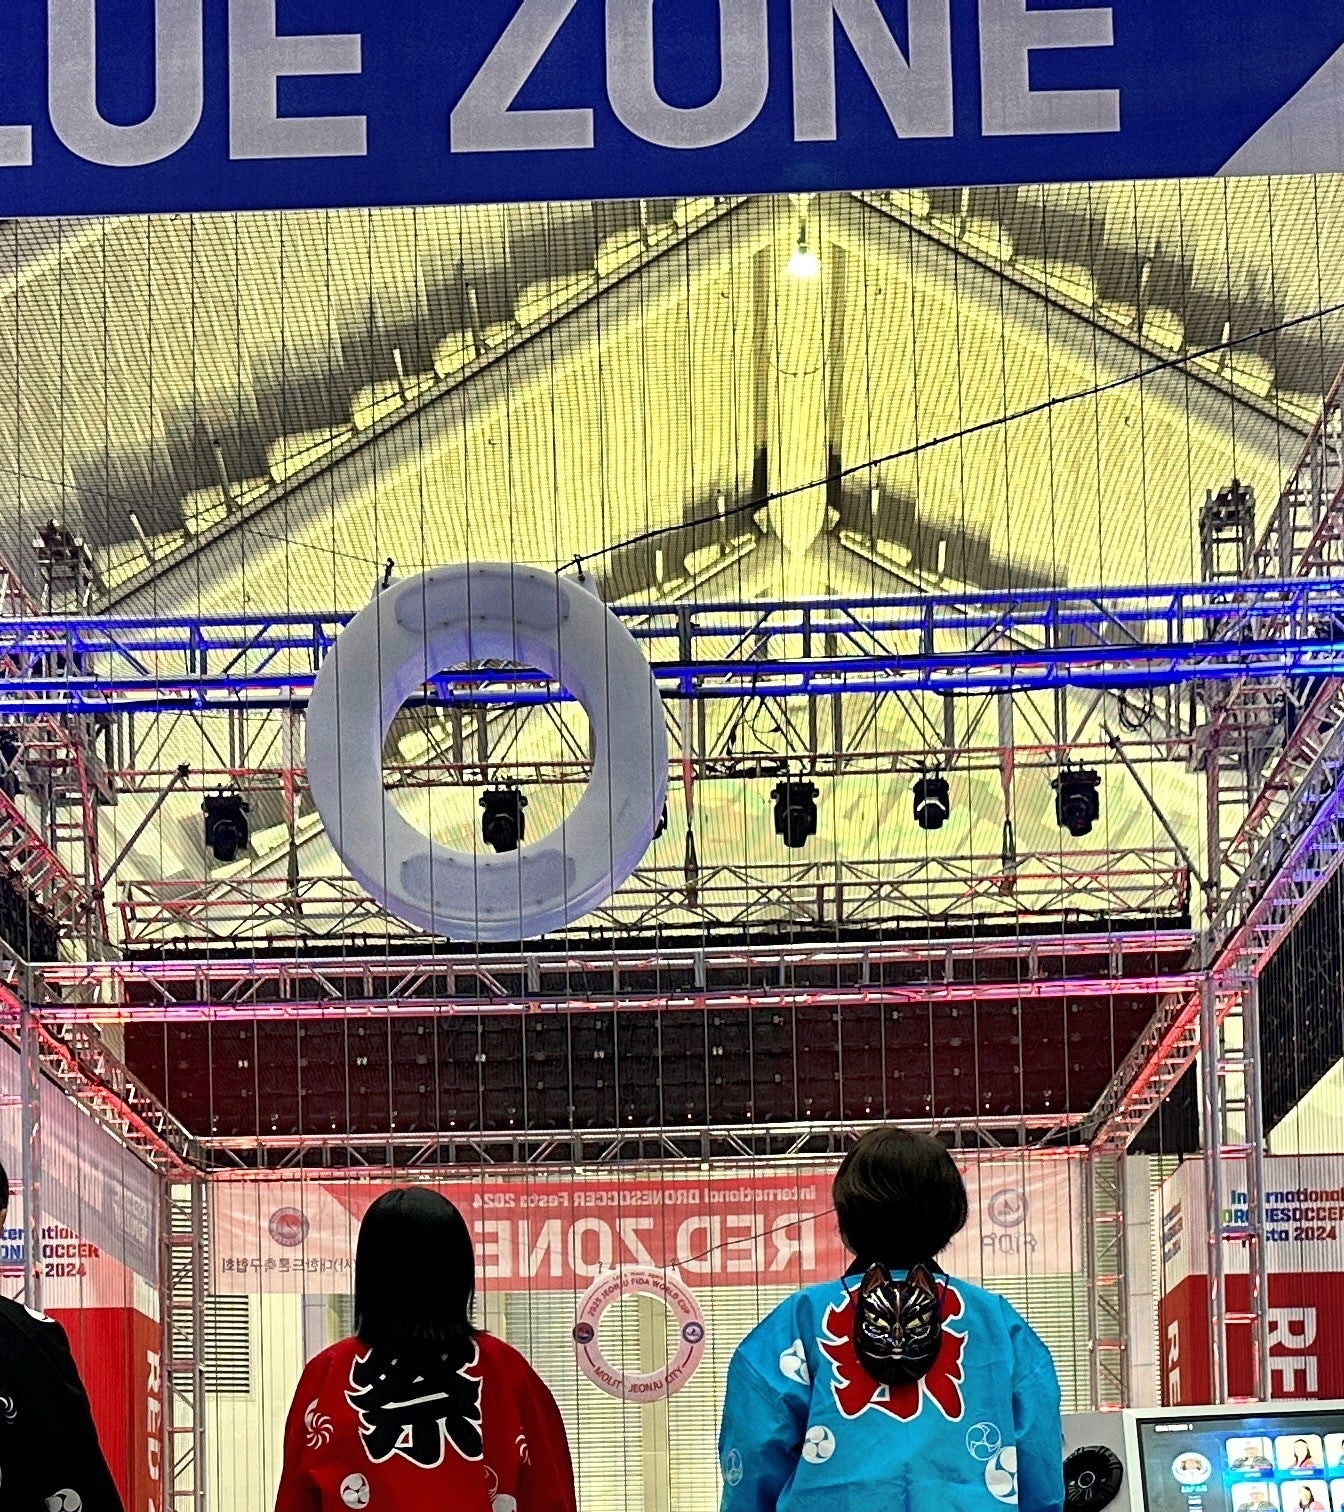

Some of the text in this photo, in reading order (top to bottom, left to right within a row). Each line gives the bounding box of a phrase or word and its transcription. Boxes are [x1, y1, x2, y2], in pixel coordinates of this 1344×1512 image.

[450, 0, 1122, 154] ZONE
[1230, 1186, 1344, 1205] Inrnational
[1293, 1226, 1337, 1242] 2024
[1268, 1307, 1319, 1400] RE
[594, 1366, 684, 1393] MOLIT JEONJU CITY
